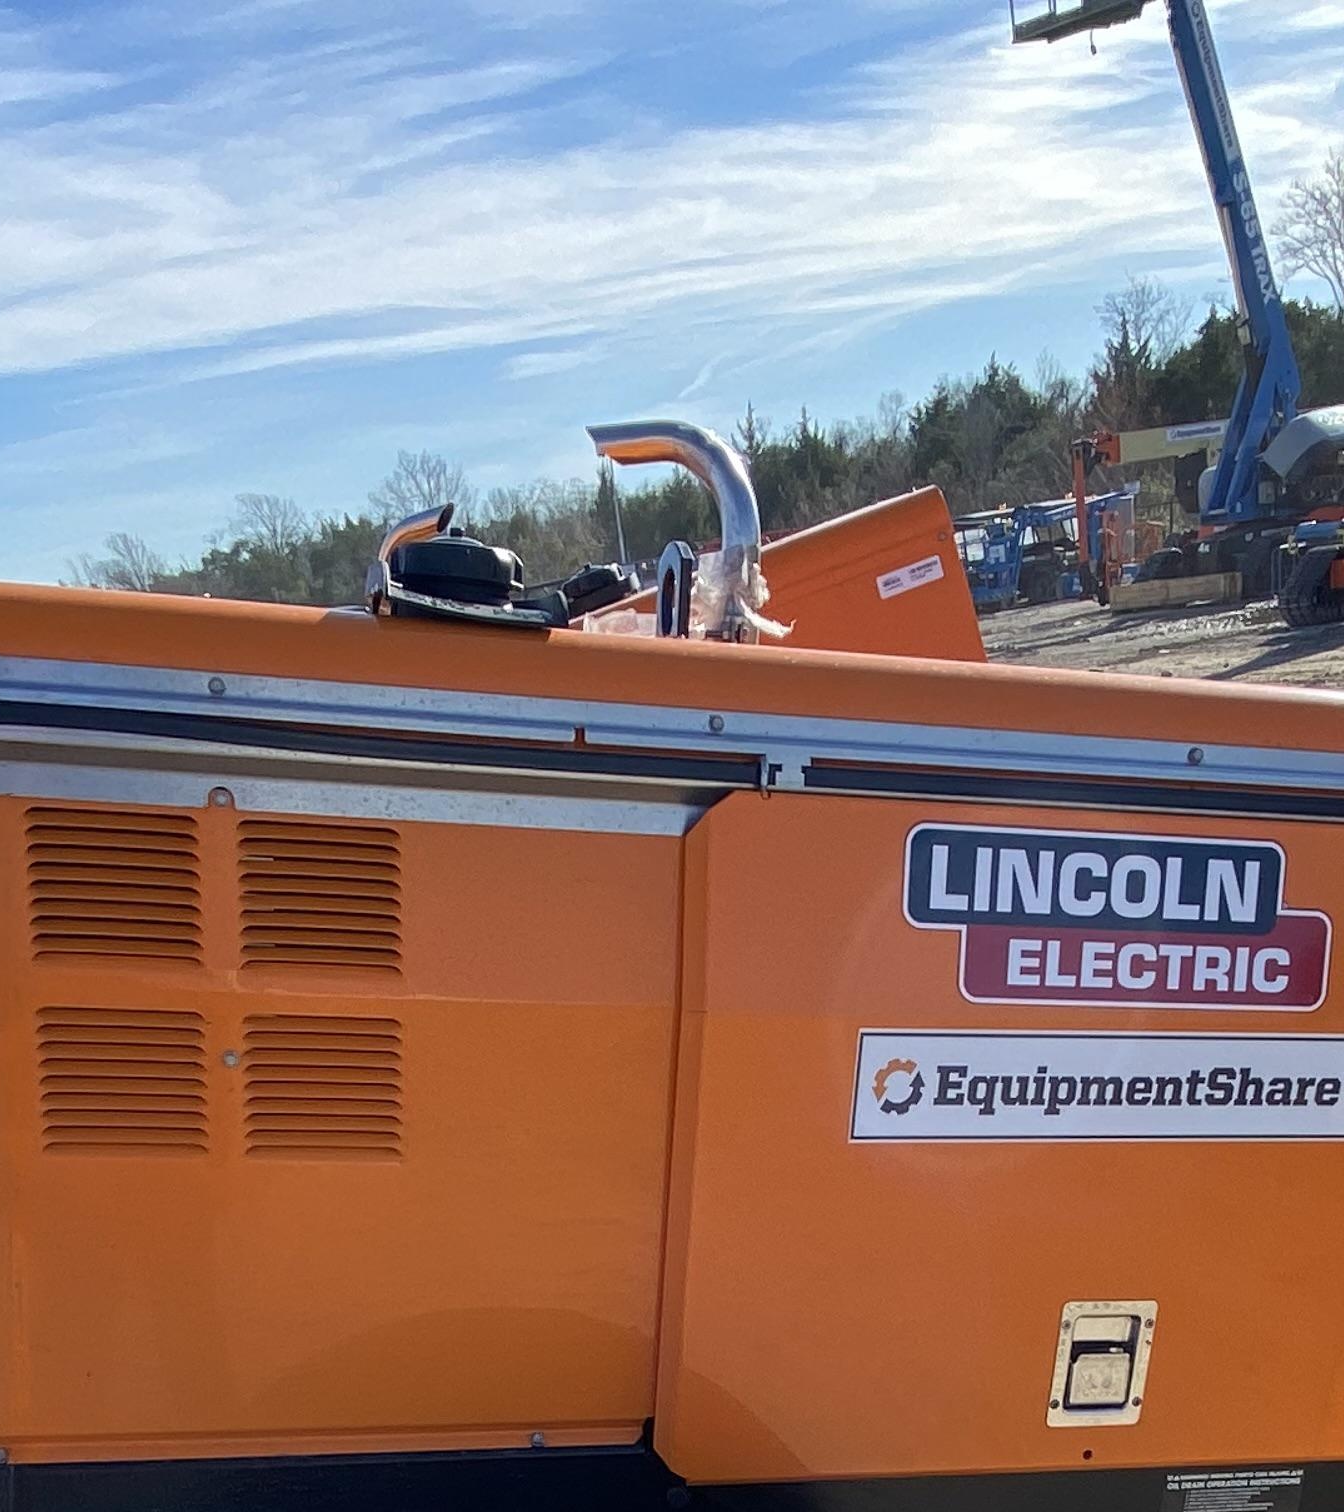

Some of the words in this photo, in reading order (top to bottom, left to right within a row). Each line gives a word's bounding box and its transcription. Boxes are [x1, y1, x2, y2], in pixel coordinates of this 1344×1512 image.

[1233, 170, 1258, 240] S-65
[929, 844, 1262, 923] LINCOLN
[1006, 938, 1292, 993] ELECTRIC
[933, 1064, 1342, 1117] EquipmentShare
